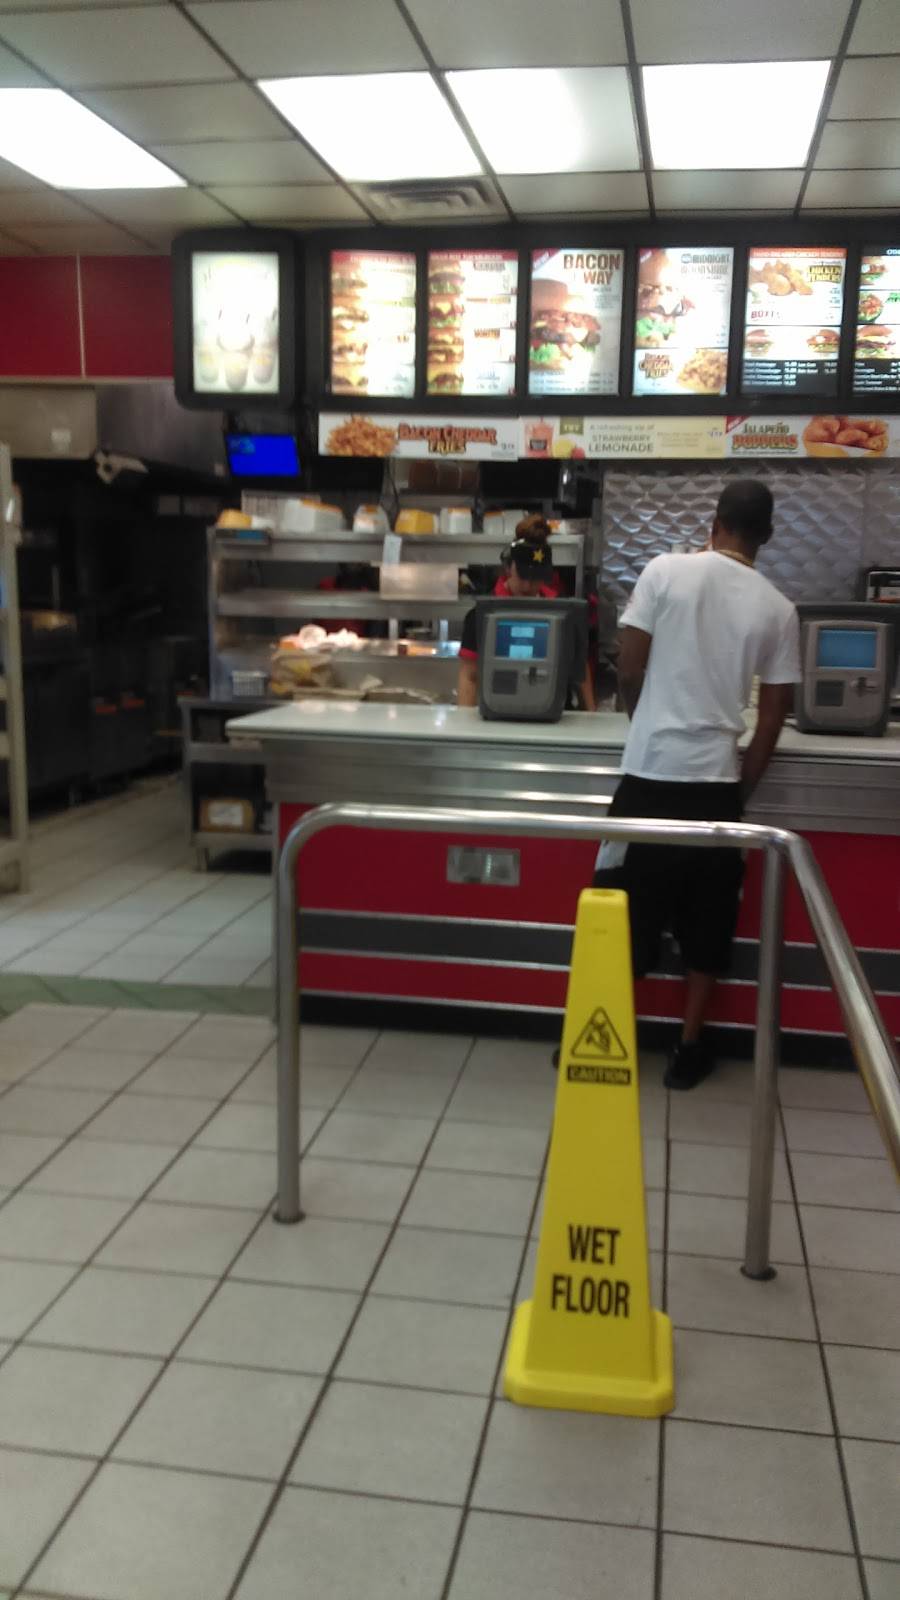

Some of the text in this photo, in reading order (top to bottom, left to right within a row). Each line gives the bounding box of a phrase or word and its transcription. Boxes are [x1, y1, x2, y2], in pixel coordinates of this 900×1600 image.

[563, 254, 621, 270] BACON
[583, 271, 613, 285] WAY
[743, 422, 790, 434] JALAPEÑO
[592, 434, 652, 442] STRAWBERRY
[428, 439, 466, 455] FRIES
[588, 442, 654, 453] LEMONADE
[569, 1066, 630, 1084] CAUTION
[567, 1223, 621, 1266] WET
[550, 1273, 631, 1319] FLOOR
